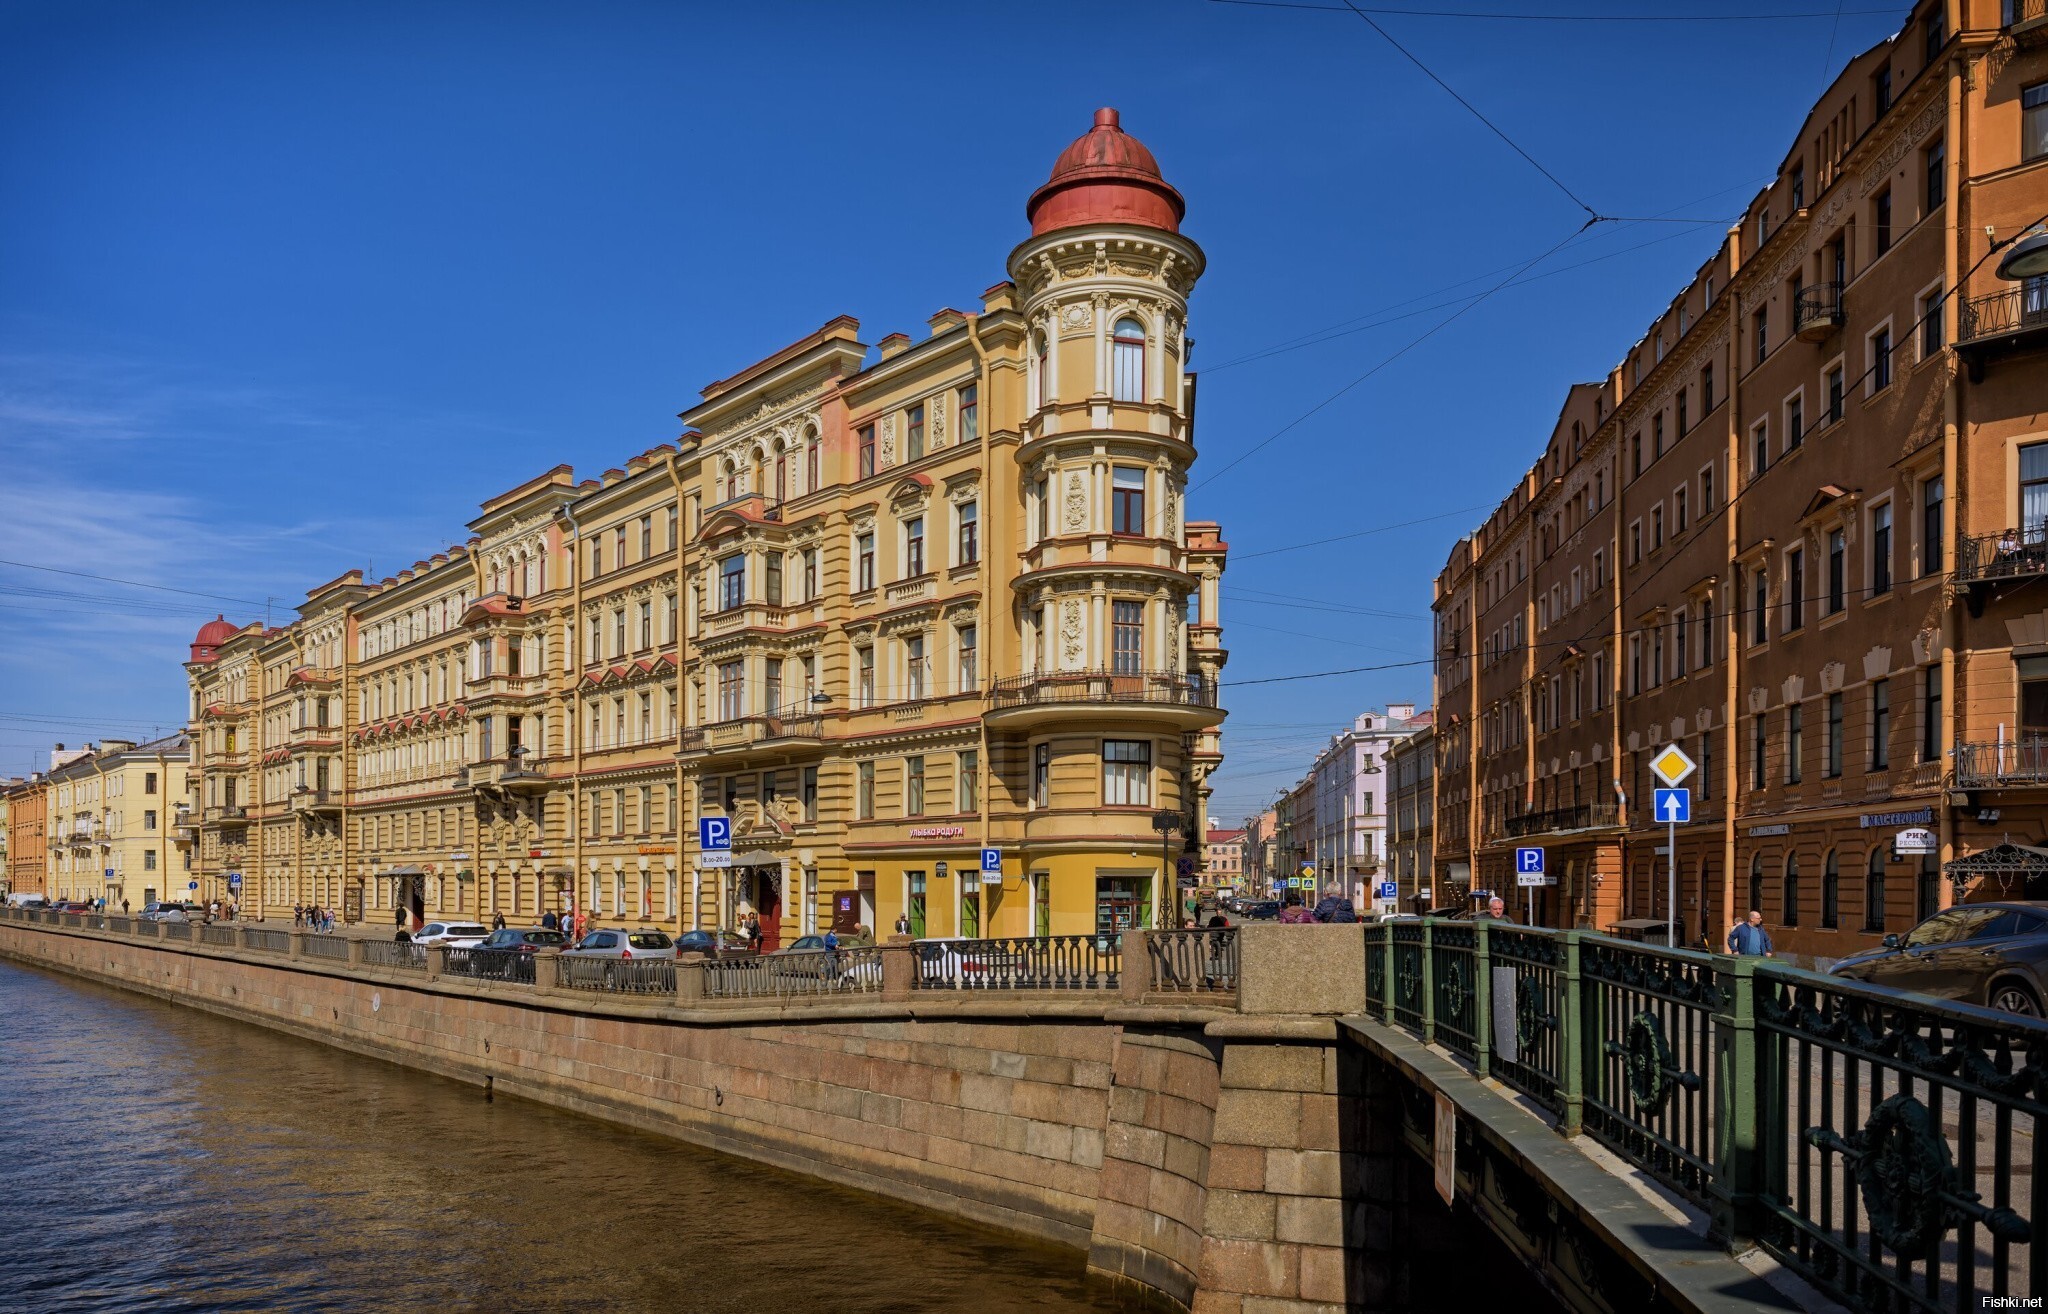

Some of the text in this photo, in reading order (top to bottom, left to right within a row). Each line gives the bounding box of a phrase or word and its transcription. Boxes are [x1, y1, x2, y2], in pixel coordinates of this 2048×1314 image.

[1868, 806, 1932, 826] МАСТЕРОВОЙ
[708, 820, 725, 846] P
[986, 851, 997, 869] P
[1524, 850, 1539, 870] P
[1385, 883, 1395, 896] P
